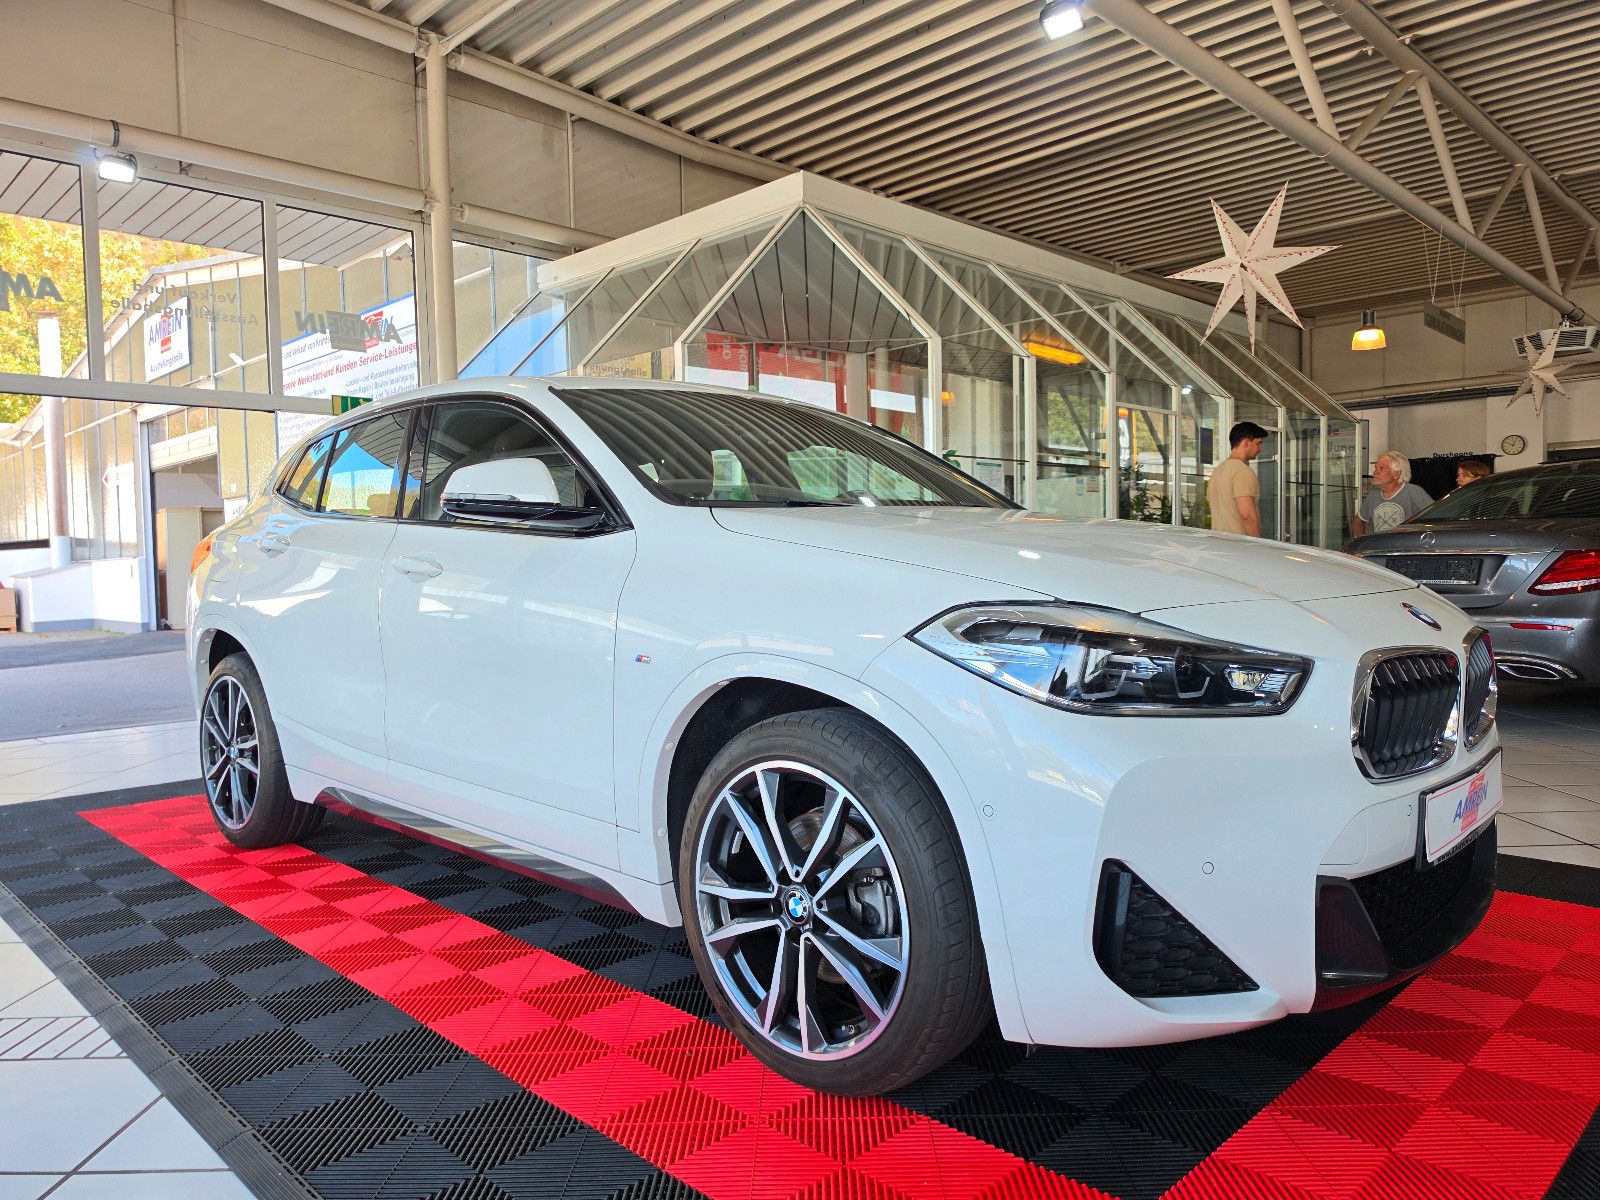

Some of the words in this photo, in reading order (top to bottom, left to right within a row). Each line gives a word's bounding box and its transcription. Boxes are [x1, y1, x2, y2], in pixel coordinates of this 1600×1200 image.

[149, 312, 182, 346] AMREIN
[282, 380, 296, 391] nsere
[335, 359, 357, 375] Kunden
[359, 342, 417, 367] Service-Leistunge
